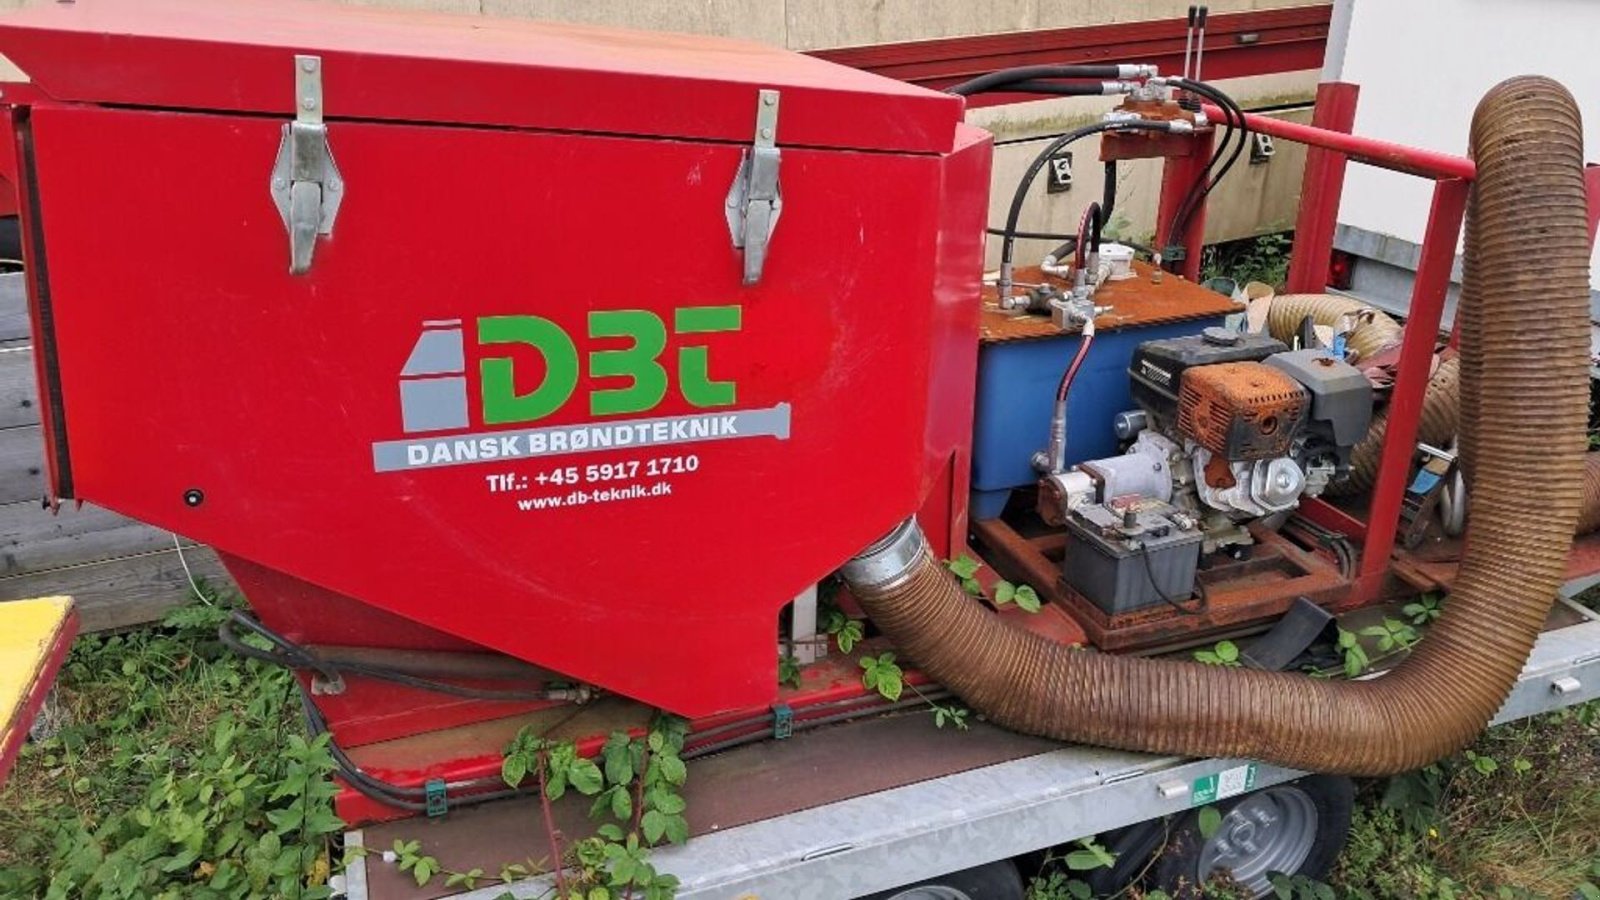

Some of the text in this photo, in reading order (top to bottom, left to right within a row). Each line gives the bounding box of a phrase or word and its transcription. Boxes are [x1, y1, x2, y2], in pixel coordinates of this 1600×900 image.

[477, 305, 742, 425] DBT
[407, 416, 739, 466] DANSK BRØNDTEKNIK
[486, 455, 699, 493] Tlf.: +45 5917 1710
[517, 481, 672, 511] www.db-teknik.dk
